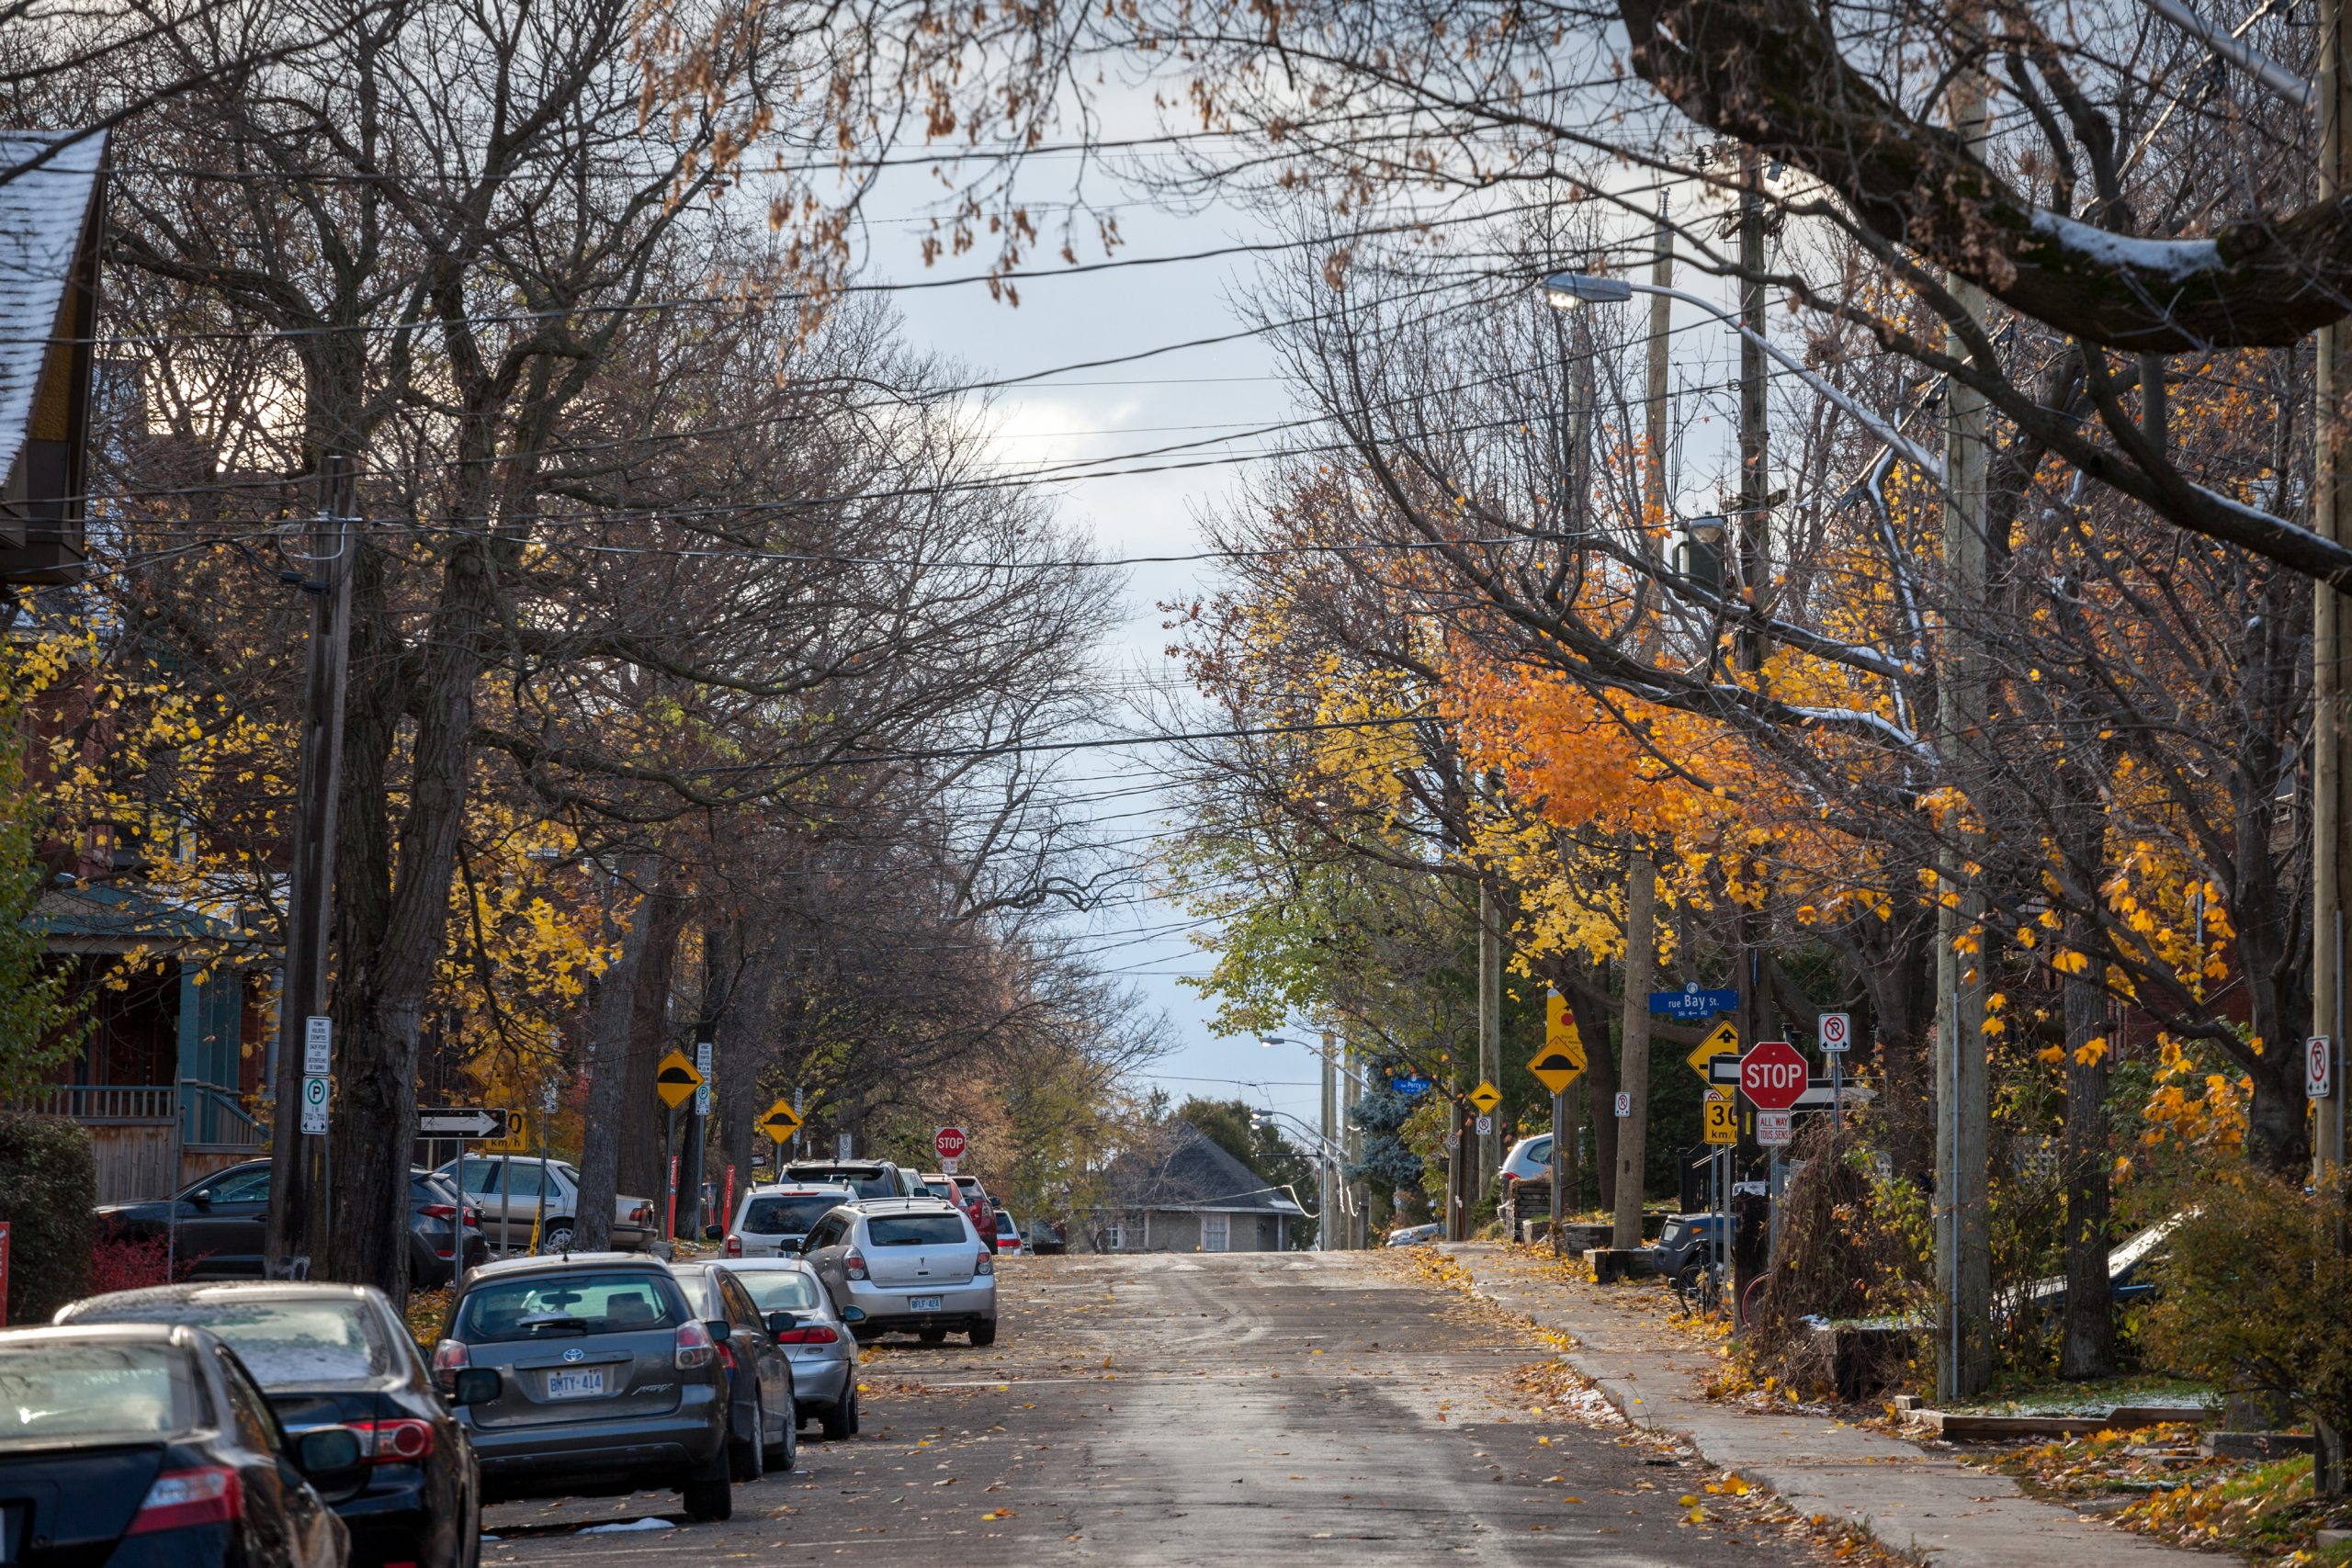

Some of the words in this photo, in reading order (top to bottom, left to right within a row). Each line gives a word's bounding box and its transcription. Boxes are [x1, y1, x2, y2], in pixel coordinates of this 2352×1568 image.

[1684, 995, 1705, 1010] Bay
[1709, 998, 1720, 1006] St.
[1747, 1064, 1802, 1088] STOP
[1760, 1117, 1773, 1127] ALL
[1774, 1117, 1788, 1127] WAY
[1759, 1130, 1773, 1140] TOUS
[1774, 1130, 1788, 1140] SENS
[491, 1138, 521, 1147] km/h
[938, 1137, 964, 1149] STOP
[550, 1376, 576, 1392] BMTY
[582, 1374, 602, 1389] 414
